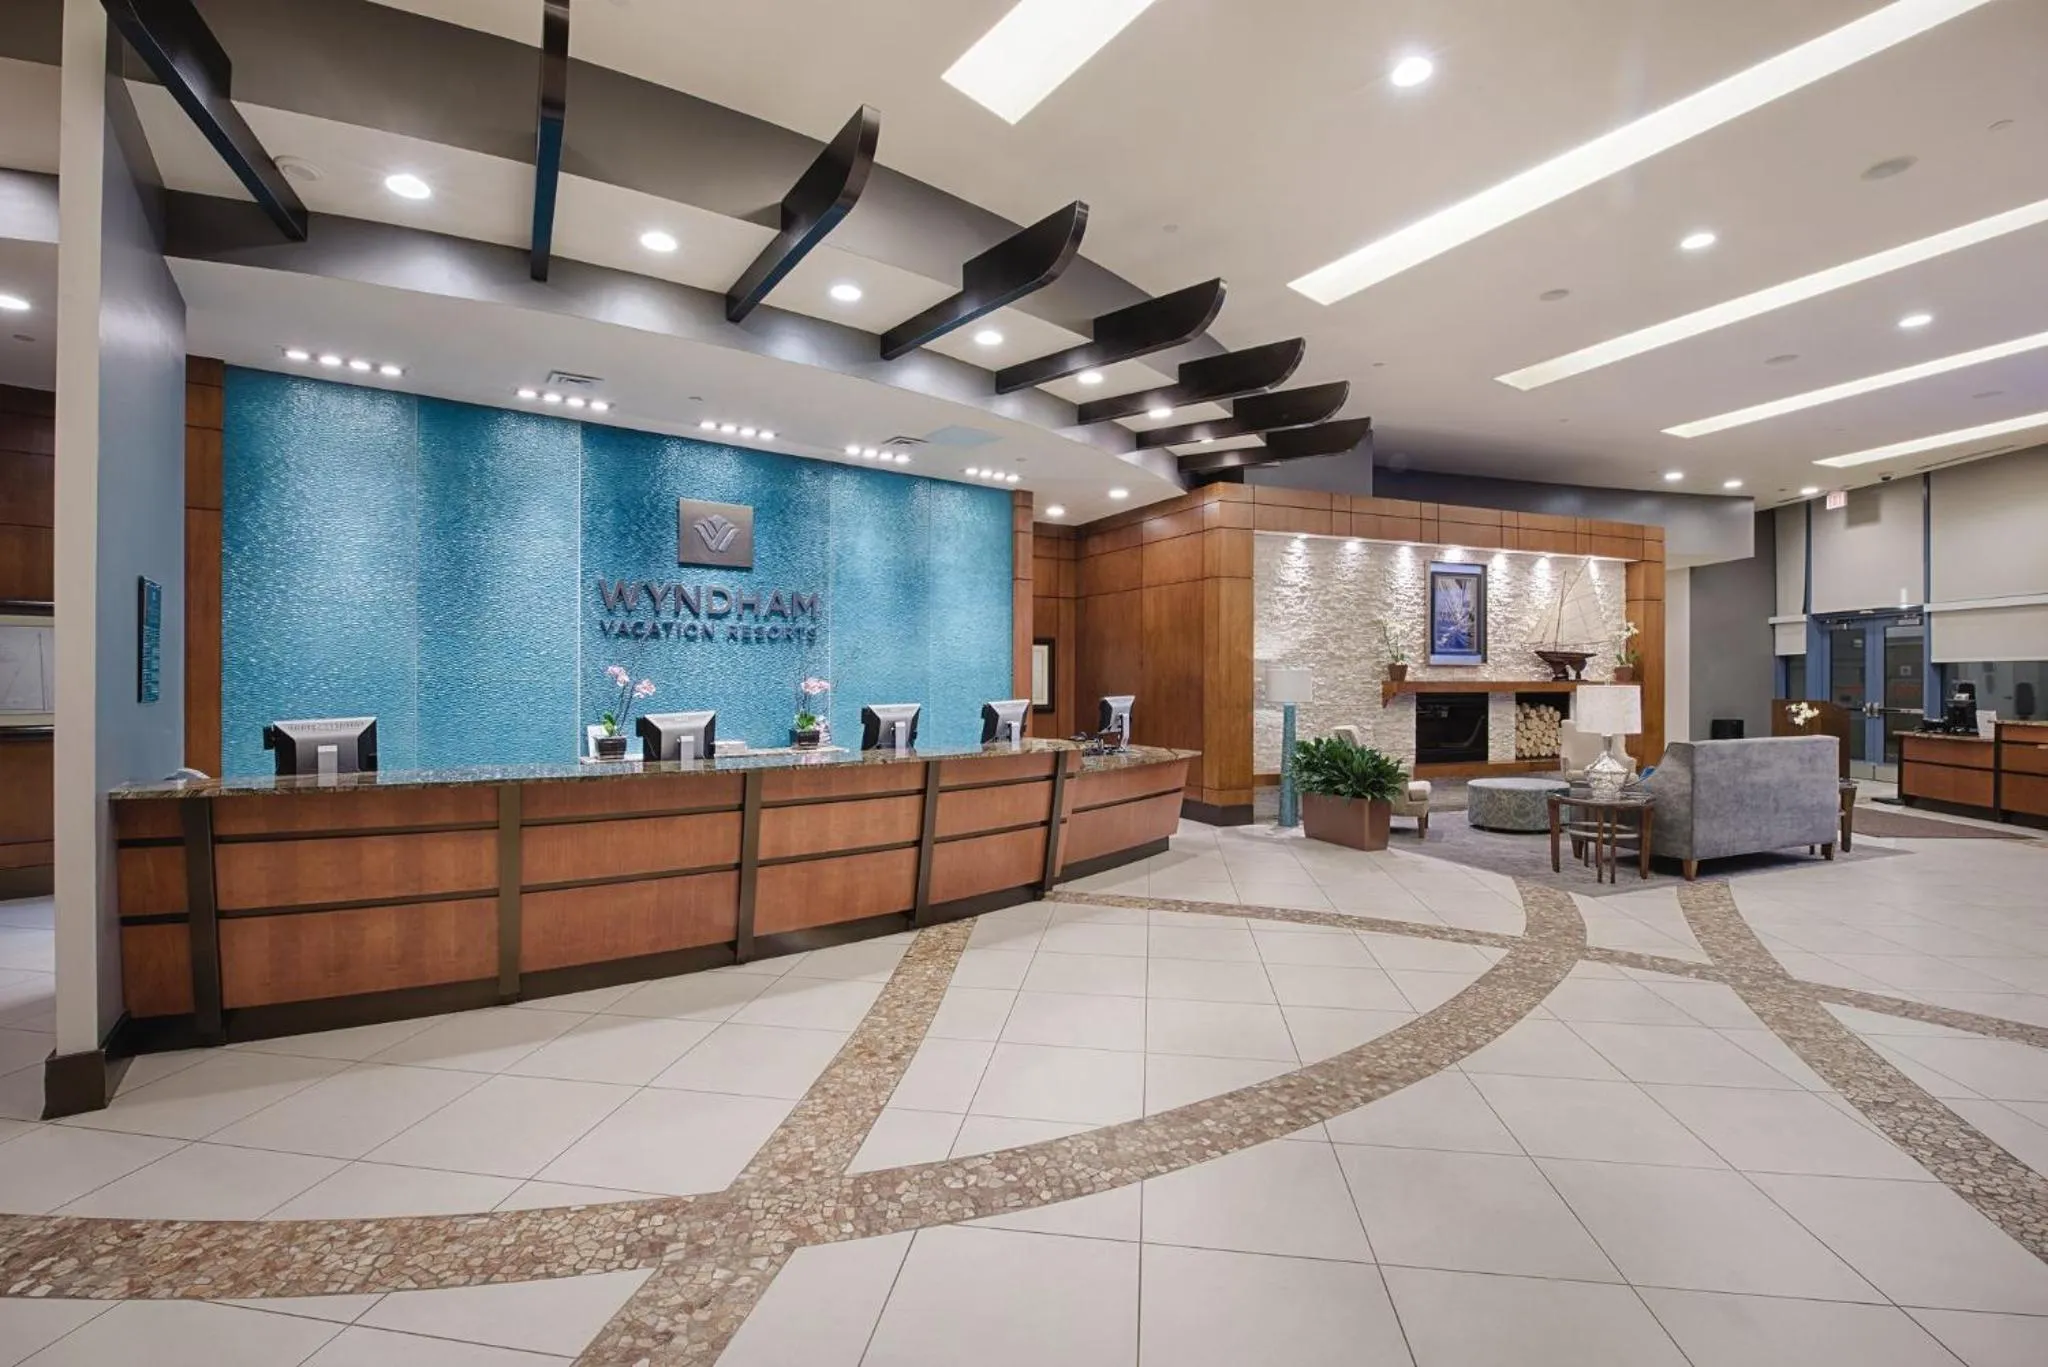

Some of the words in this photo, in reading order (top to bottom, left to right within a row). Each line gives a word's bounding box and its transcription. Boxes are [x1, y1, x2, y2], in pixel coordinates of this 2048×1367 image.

[599, 578, 820, 619] WYNDHAM
[600, 619, 715, 641] VACATION
[728, 624, 817, 644] RESORTS
